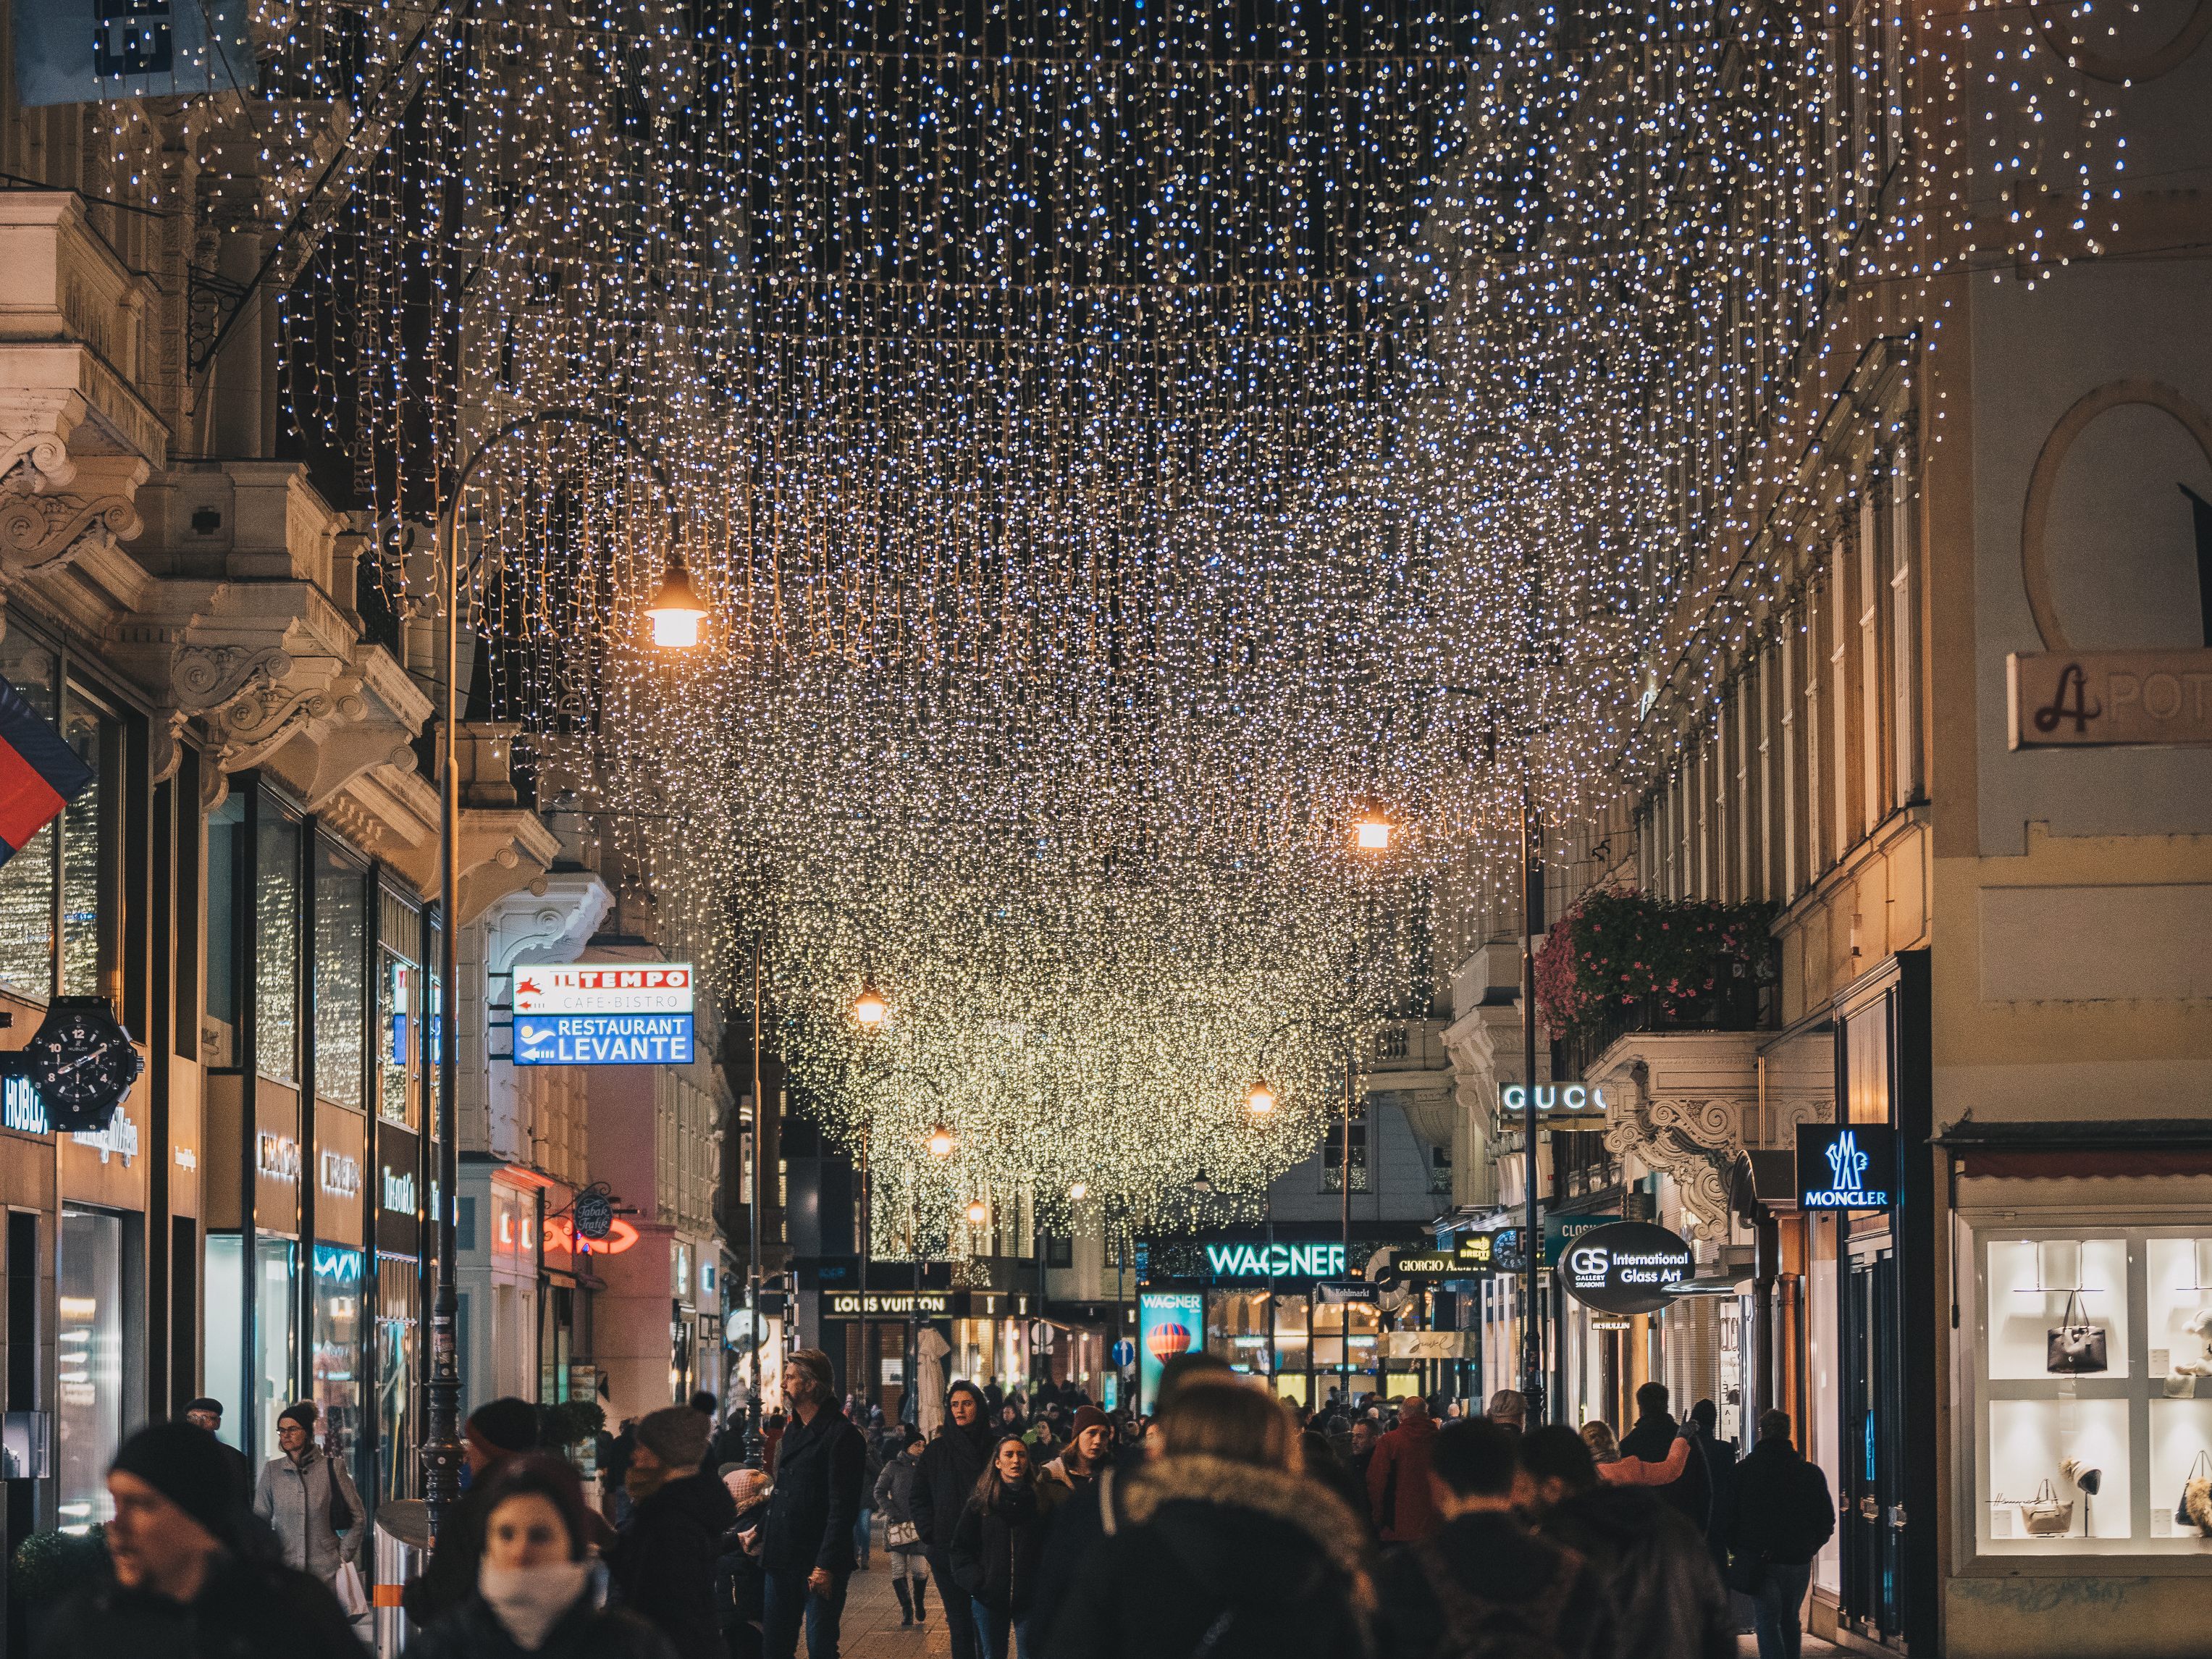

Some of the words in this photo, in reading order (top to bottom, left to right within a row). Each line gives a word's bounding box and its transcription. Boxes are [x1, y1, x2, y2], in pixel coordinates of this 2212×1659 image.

[554, 974, 575, 987] IL
[579, 971, 686, 988] TEMPO
[558, 1019, 686, 1036] RESTAURANT
[558, 1037, 686, 1060] LEVANTE
[1805, 1191, 1888, 1206] MONCLER
[579, 1204, 609, 1218] Tabak
[579, 1217, 609, 1230] Trafik
[1206, 1244, 1345, 1276] WAGNER
[1399, 1260, 1444, 1272] GIORGIO
[1571, 1248, 1608, 1274] GS
[1612, 1252, 1689, 1266] International
[1620, 1269, 1658, 1282] Glass
[1660, 1269, 1682, 1282] Art
[1335, 1288, 1370, 1297] Kohlmarkt
[1141, 1295, 1200, 1309] WAGNER
